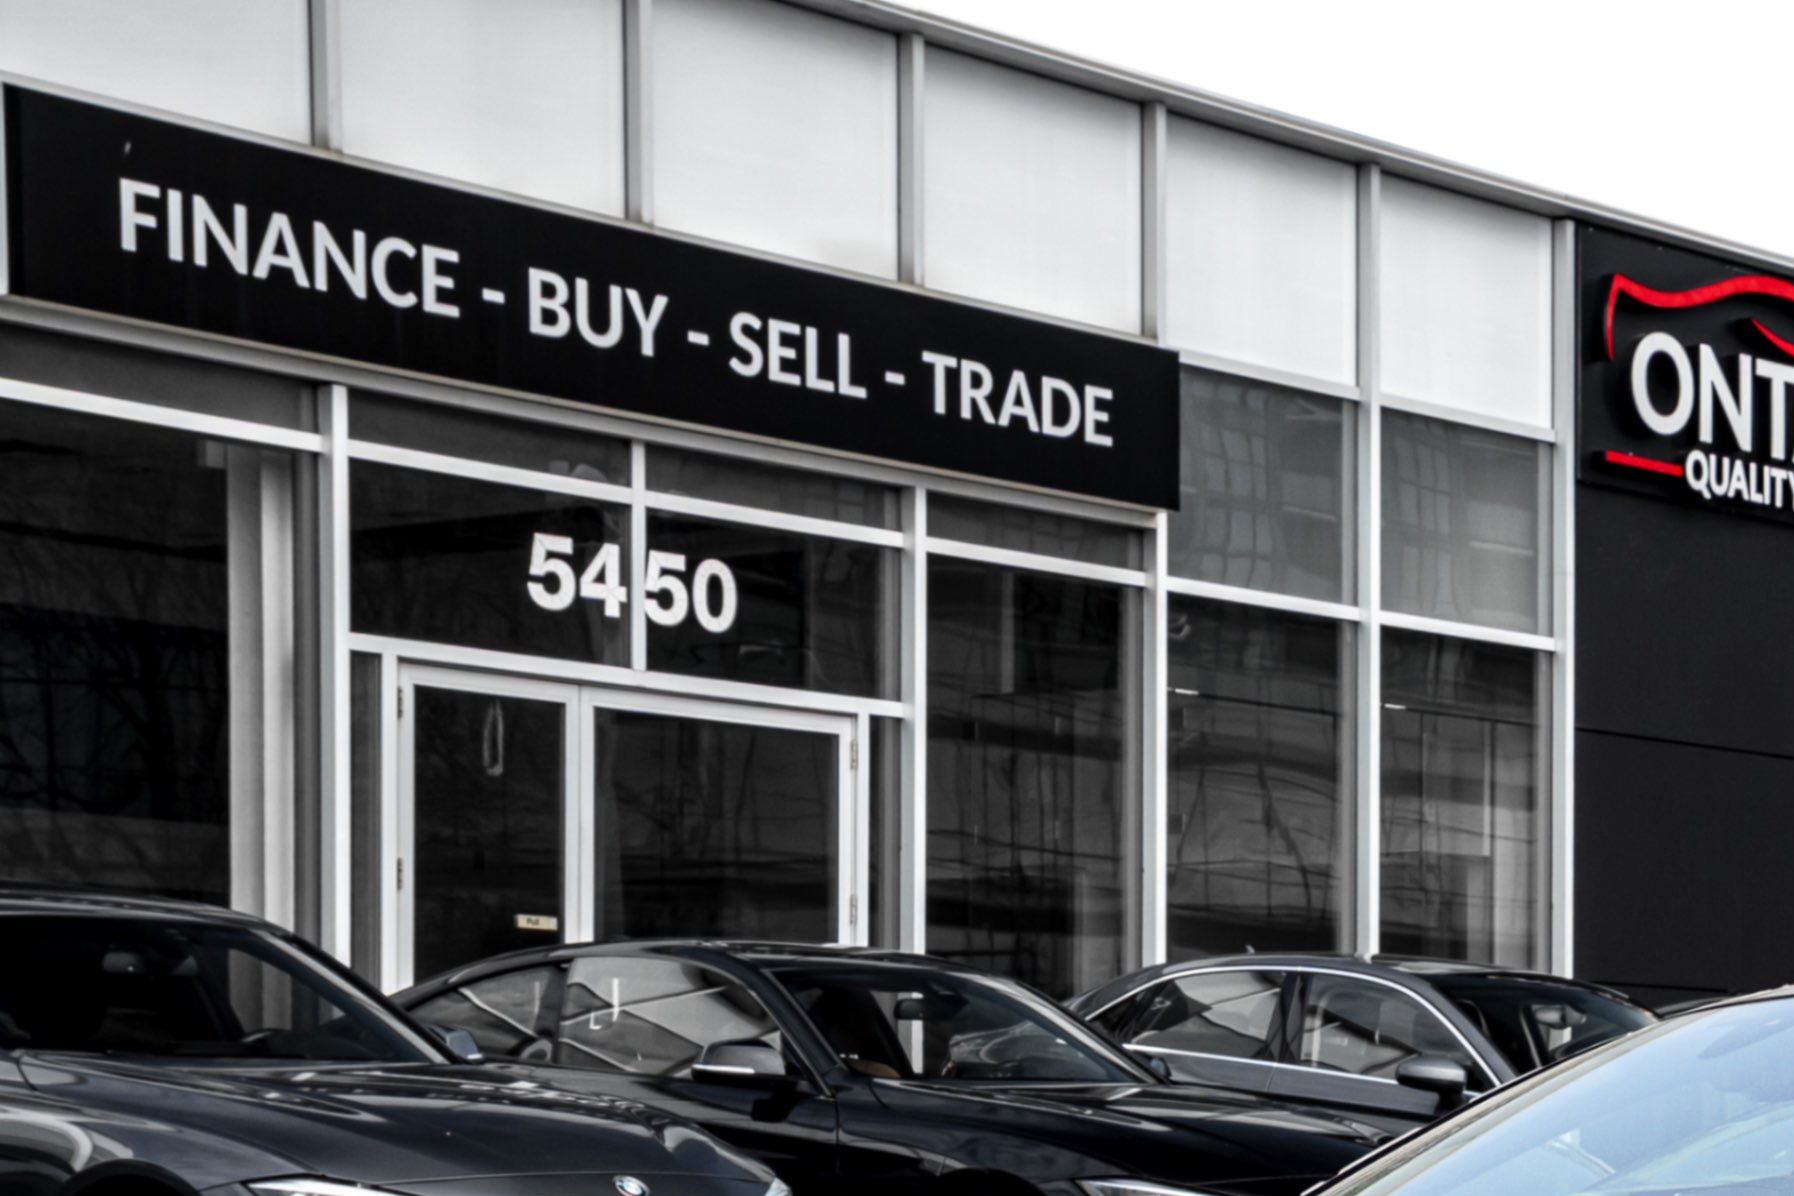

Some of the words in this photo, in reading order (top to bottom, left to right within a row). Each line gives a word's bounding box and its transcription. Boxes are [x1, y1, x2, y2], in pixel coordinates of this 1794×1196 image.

[118, 176, 461, 318] FINANCE
[528, 267, 669, 357] BUY
[729, 311, 867, 399] SELL
[921, 350, 1114, 448] TRADE
[526, 532, 738, 634] 5450
